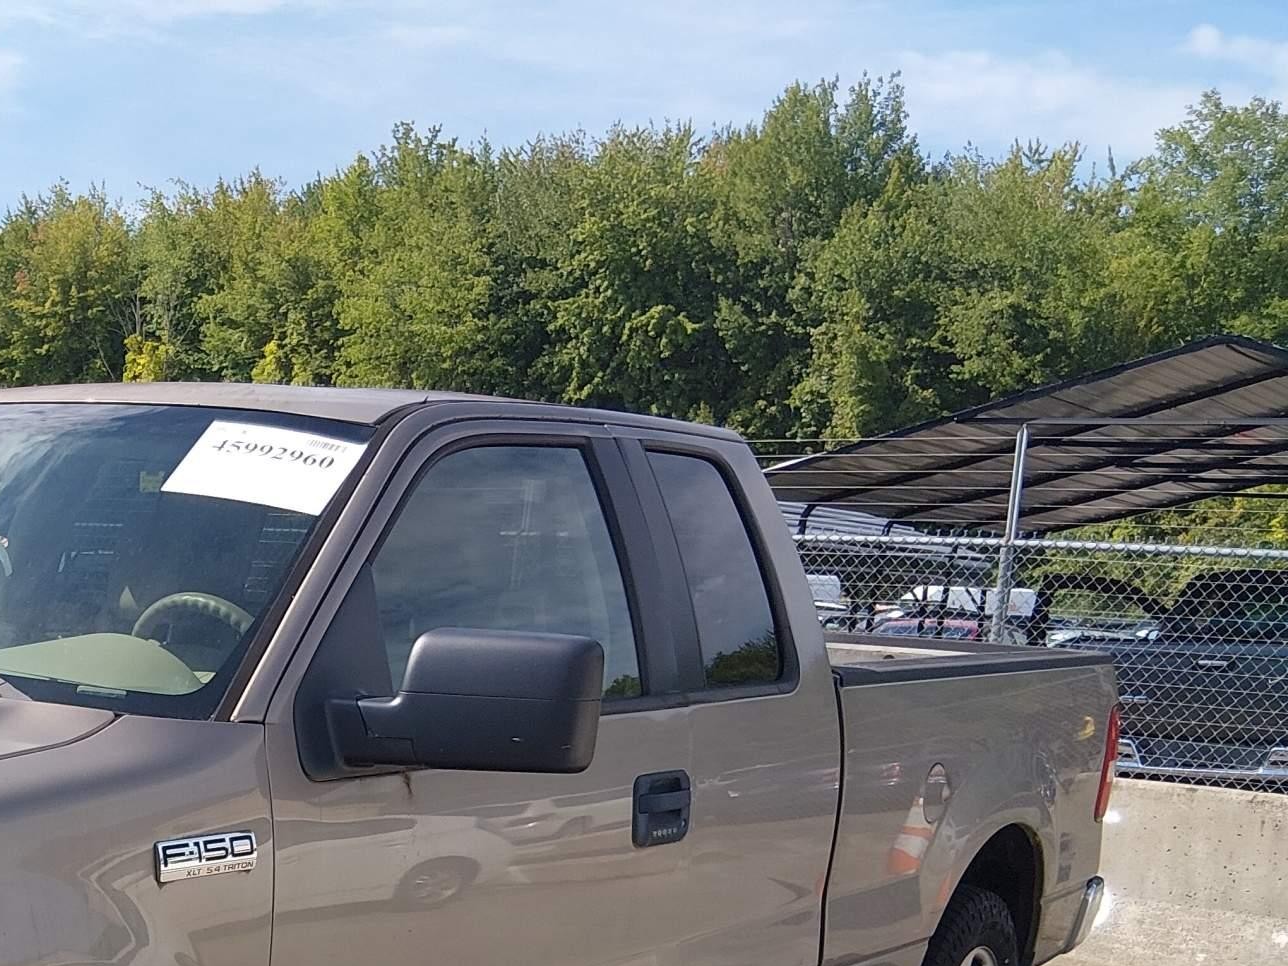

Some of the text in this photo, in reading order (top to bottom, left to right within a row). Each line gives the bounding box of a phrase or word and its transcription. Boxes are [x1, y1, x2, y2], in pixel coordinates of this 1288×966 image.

[212, 439, 335, 469] 45992960
[161, 834, 254, 868] F-150
[186, 868, 202, 877] XLT
[223, 861, 254, 871] TRITON
